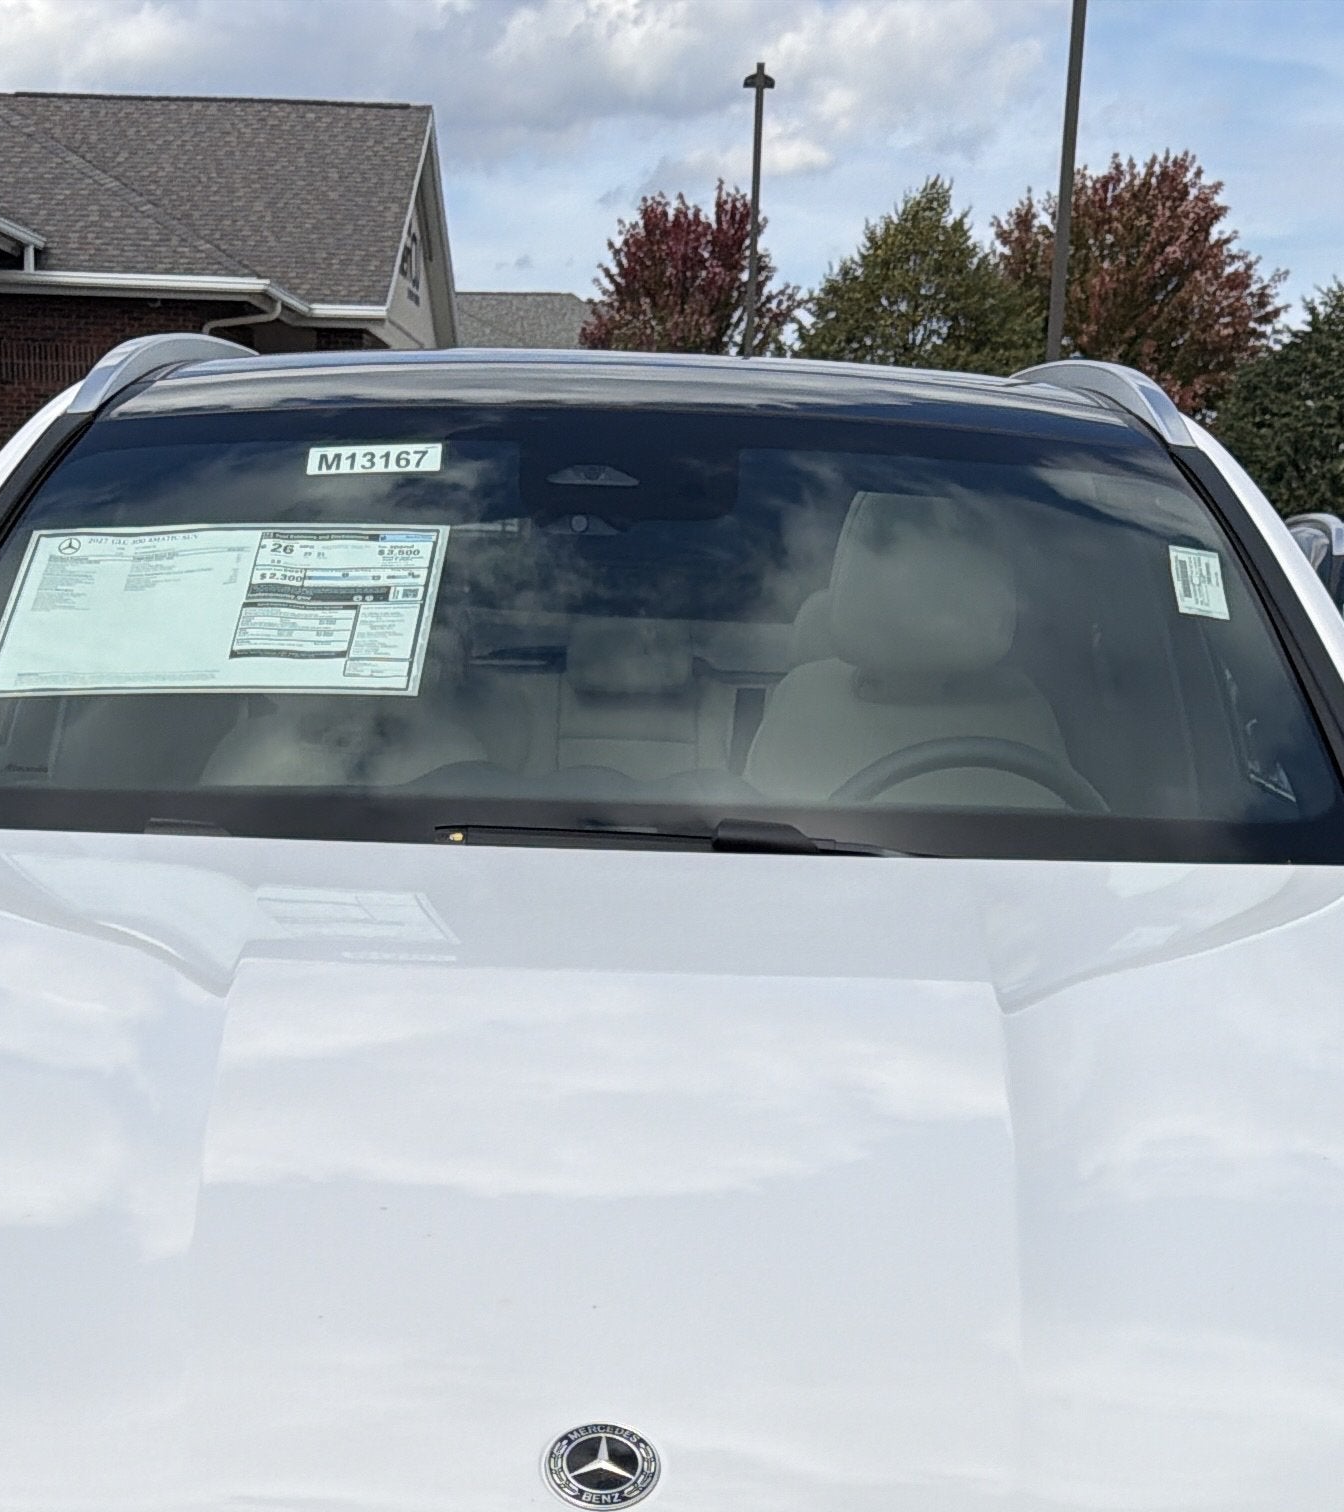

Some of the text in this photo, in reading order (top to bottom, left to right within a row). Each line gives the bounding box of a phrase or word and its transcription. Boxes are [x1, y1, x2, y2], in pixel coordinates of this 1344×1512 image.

[317, 450, 429, 472] M13167
[270, 542, 295, 554] 26
[566, 1424, 641, 1443] MERCEDES
[581, 1493, 622, 1504] BENZ
